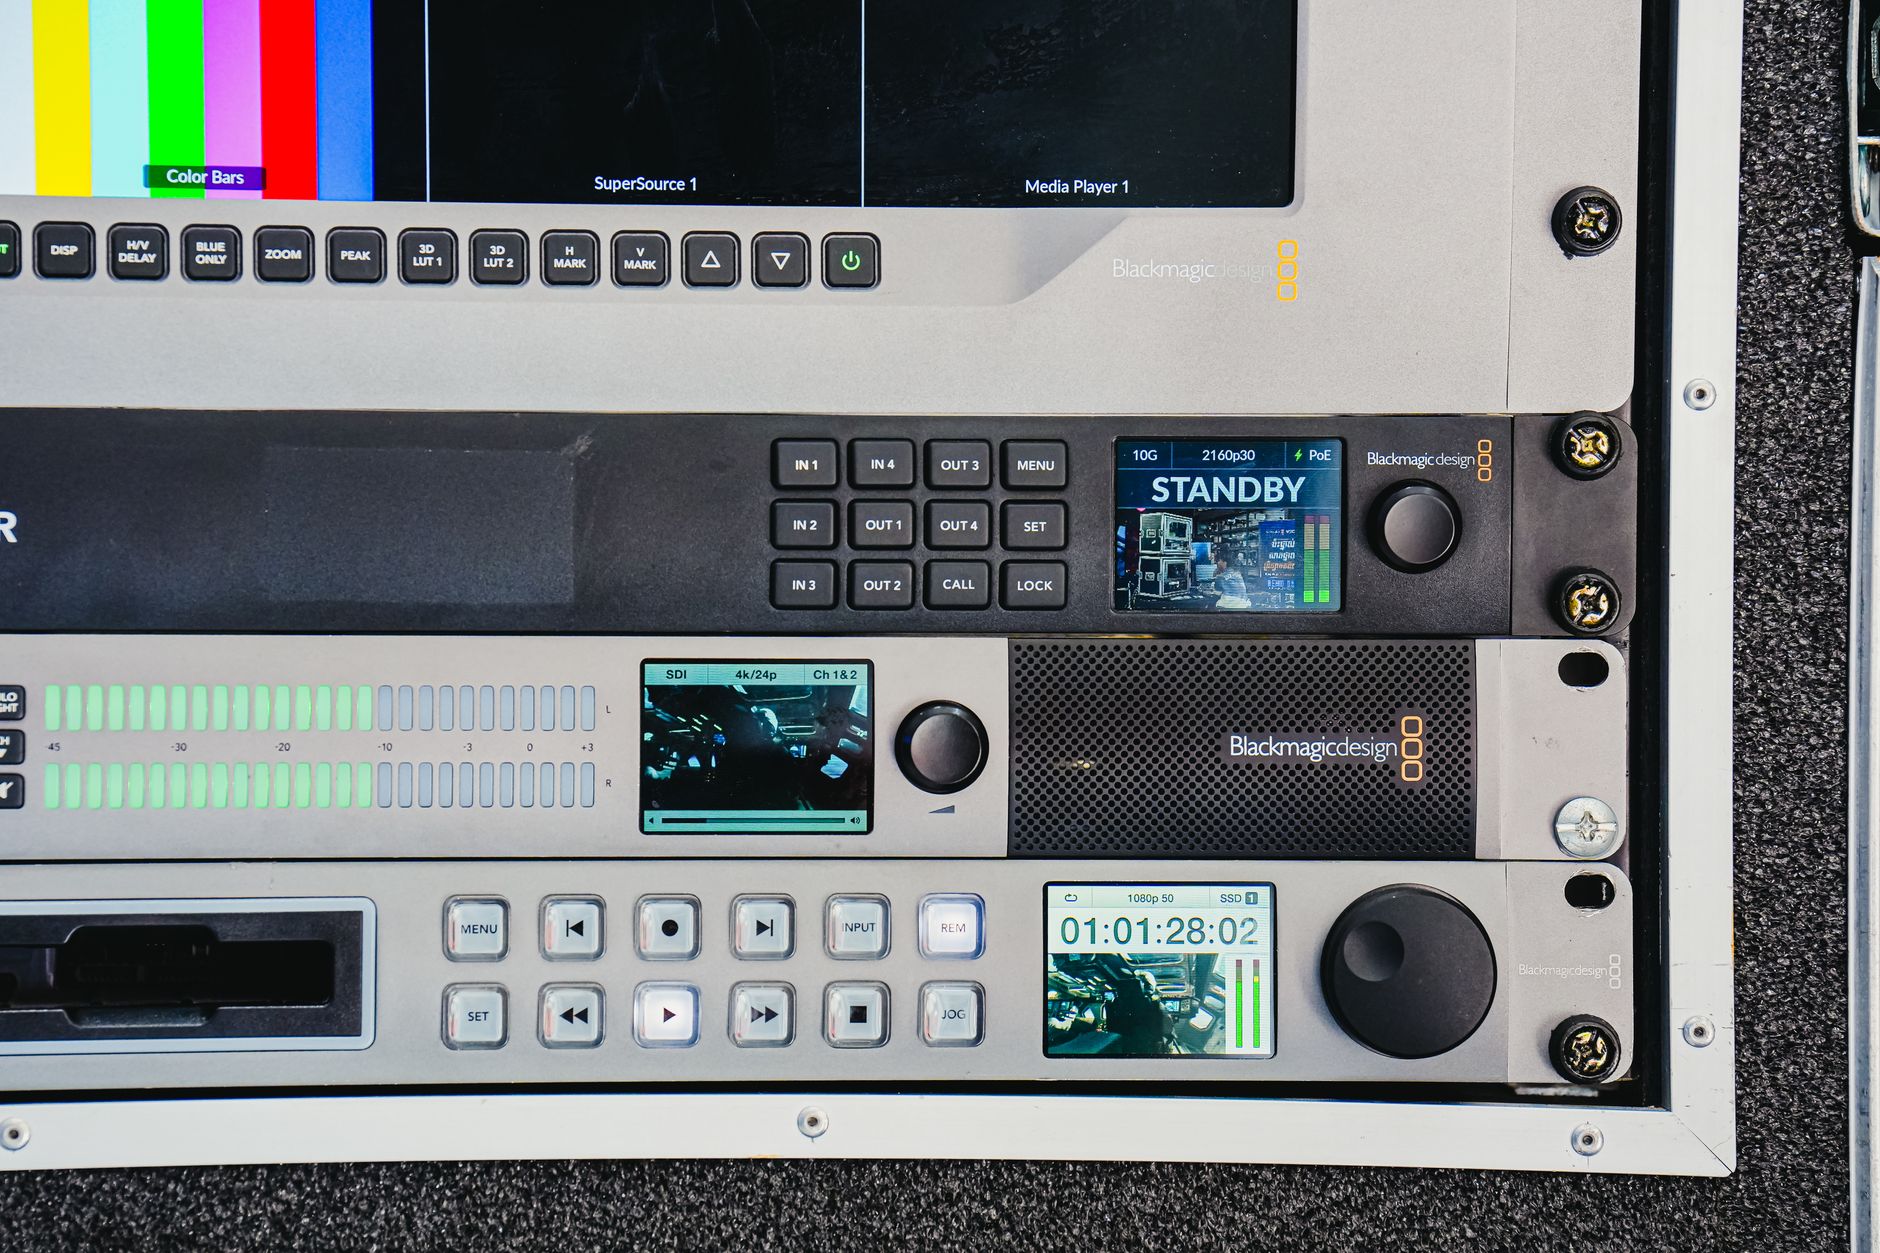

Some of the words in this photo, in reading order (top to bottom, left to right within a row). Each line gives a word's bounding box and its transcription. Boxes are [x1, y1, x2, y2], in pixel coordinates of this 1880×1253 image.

[166, 168, 208, 185] Color
[212, 170, 244, 185] Bars
[594, 177, 686, 193] SuperSource
[690, 178, 697, 191] 1
[1025, 180, 1069, 194] Media
[1074, 180, 1118, 196] Player
[1122, 181, 1129, 193] 1
[50, 245, 78, 256] DISP
[126, 241, 150, 251] H/V
[195, 241, 226, 253] BLUE
[418, 244, 435, 254] 3D
[490, 246, 505, 255] 3D
[565, 246, 574, 256] H
[118, 252, 156, 263] DELAY
[265, 249, 302, 260] ZOOM
[341, 250, 371, 261] PEAK
[636, 248, 645, 257] V
[195, 254, 227, 265] ONLY
[413, 256, 435, 267] LUT
[437, 257, 442, 267] 1
[483, 258, 505, 268] LUT
[506, 258, 514, 268] 2
[553, 258, 586, 268] MARK
[624, 259, 656, 270] MARK
[1132, 450, 1158, 461] 10G
[1202, 450, 1256, 463] 2160p30
[1309, 450, 1332, 461] PoE
[795, 460, 809, 471] IN
[812, 460, 818, 471] 1
[871, 459, 885, 470] IN
[887, 459, 895, 470] 4
[941, 460, 968, 471] OUT
[972, 460, 979, 471] 3
[1017, 460, 1055, 471] MENU
[1151, 476, 1306, 503] STANDBY
[793, 520, 807, 530] IN
[809, 520, 817, 530] 2
[866, 519, 894, 530] OUT
[896, 519, 902, 530] 1
[940, 520, 968, 531] OUT
[970, 520, 978, 531] 4
[1023, 522, 1047, 532] SET
[792, 580, 806, 591] IN
[808, 580, 816, 591] 3
[864, 580, 892, 591] OUT
[893, 580, 901, 591] 2
[943, 579, 975, 590] CALL
[1017, 580, 1053, 591] LOCK
[666, 670, 687, 680] SDI
[735, 670, 777, 682] 4k/24p
[813, 670, 830, 680] Ch
[606, 706, 611, 714] L
[45, 743, 61, 751] -45
[171, 743, 187, 752] -30
[275, 743, 291, 752] -20
[378, 743, 393, 752] -10
[463, 743, 473, 752] -3
[527, 743, 533, 752] 0
[581, 743, 594, 752] +3
[606, 779, 612, 788] R
[1127, 894, 1159, 905] 1080p
[1162, 894, 1174, 903] 50
[1220, 893, 1242, 903] SSD
[461, 924, 498, 934] MENU
[841, 922, 876, 933] INPUT
[941, 923, 966, 933] REM
[1061, 917, 1258, 945] 01:01:28:02
[468, 1011, 489, 1021] SET
[942, 1009, 966, 1020] JOG
